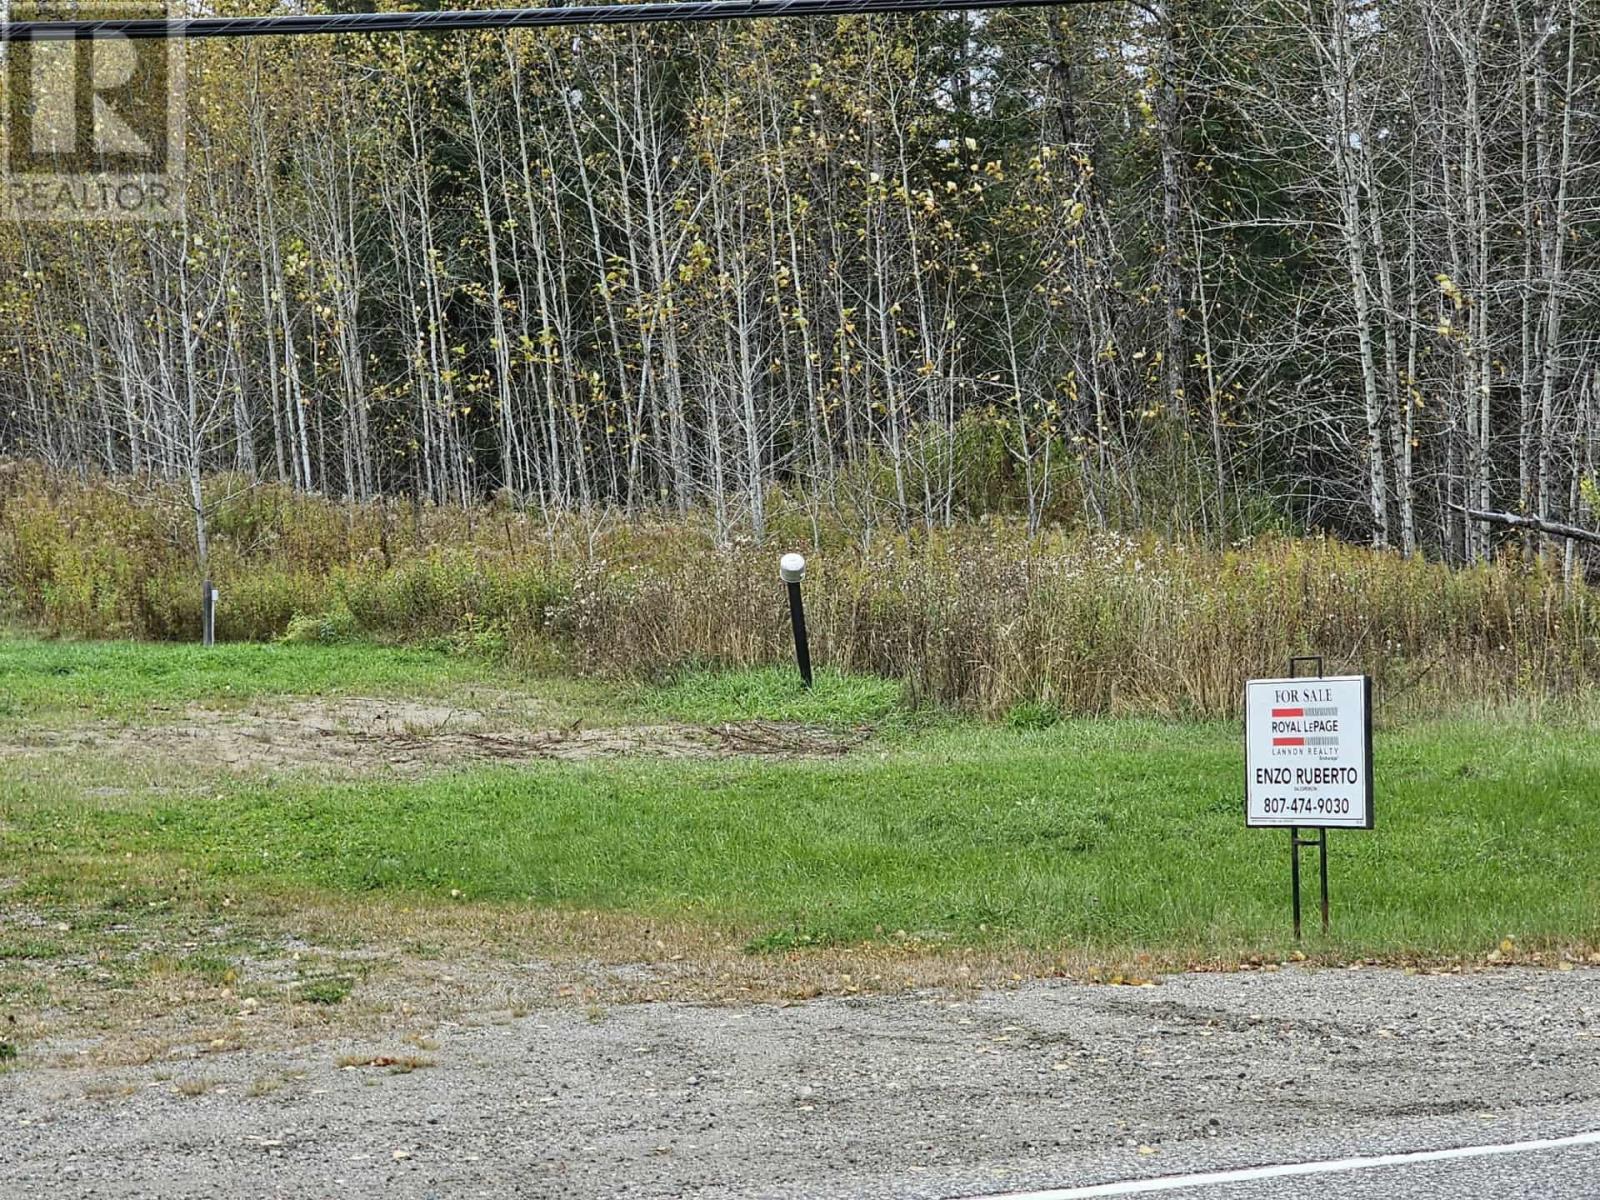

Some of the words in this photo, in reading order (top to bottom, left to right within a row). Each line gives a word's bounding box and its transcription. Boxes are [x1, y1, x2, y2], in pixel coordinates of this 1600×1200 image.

[1275, 689, 1299, 703] FOR
[1303, 688, 1333, 703] SALE
[1272, 721, 1302, 733] ROYAL
[1272, 748, 1303, 756] LANNON
[1308, 747, 1339, 755] REALTY
[1256, 768, 1292, 785] ENZO
[1296, 767, 1358, 785] RUBERTO
[1264, 798, 1350, 814] 807-474-9030
